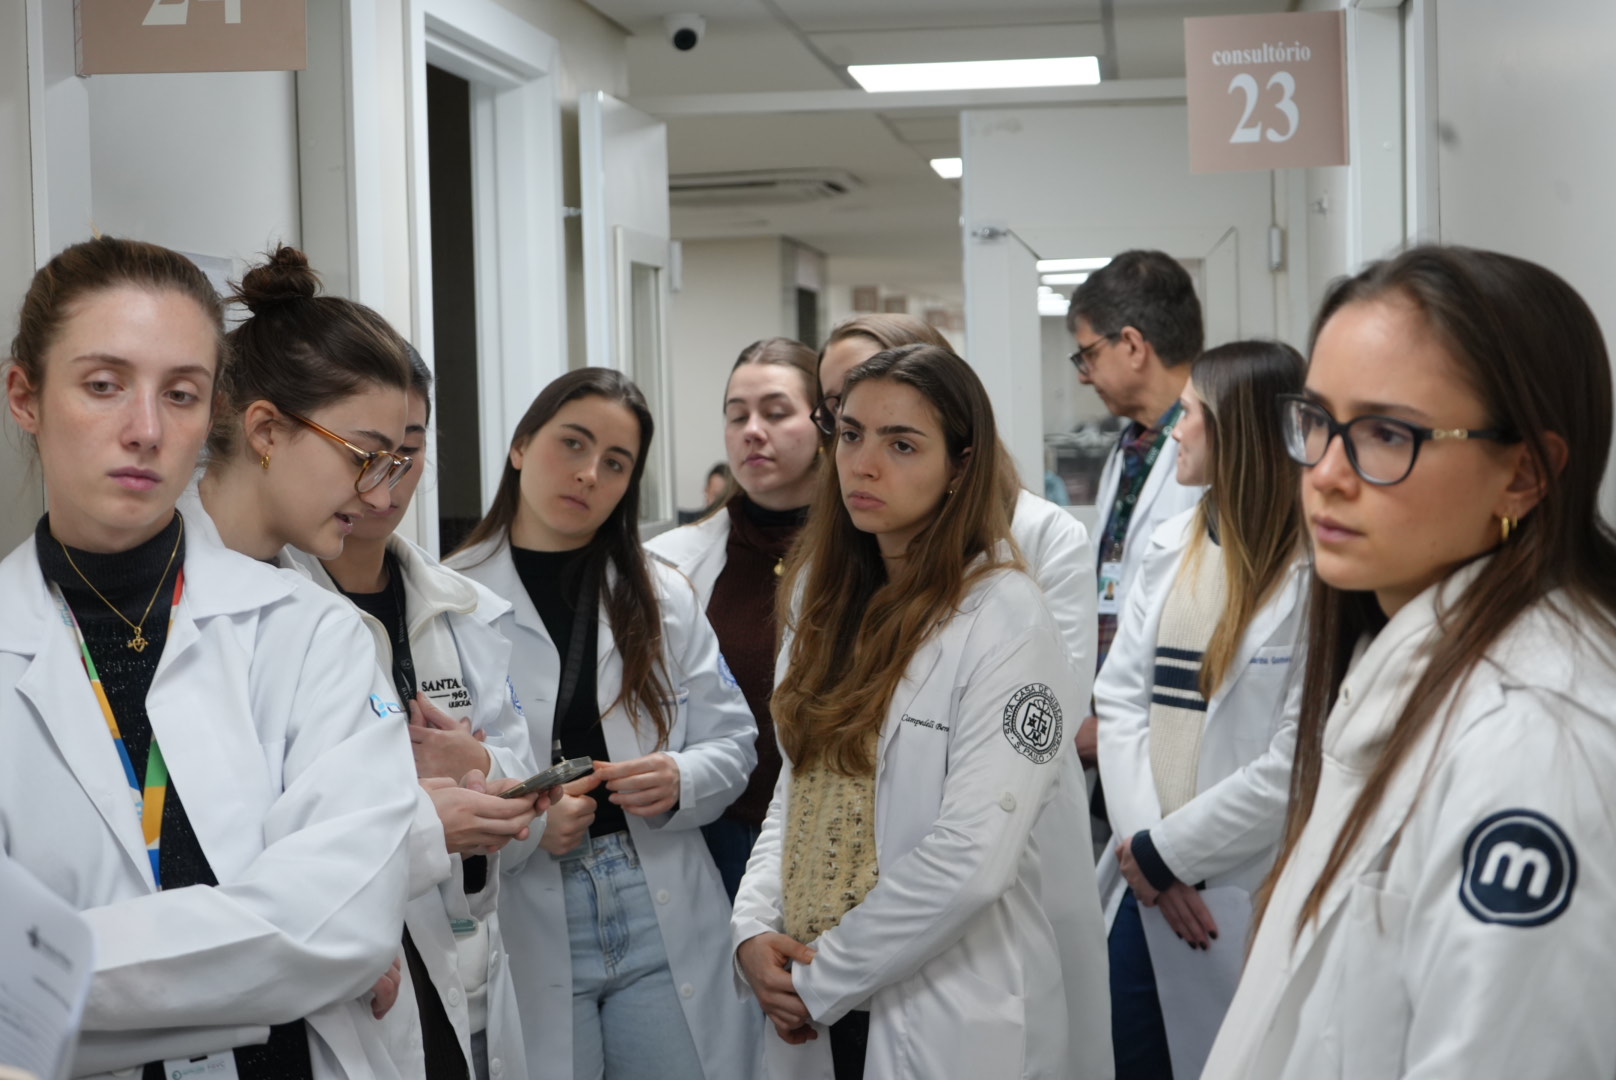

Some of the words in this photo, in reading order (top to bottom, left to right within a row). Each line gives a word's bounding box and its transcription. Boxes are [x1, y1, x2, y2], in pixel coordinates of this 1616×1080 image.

[1211, 41, 1312, 66] consultório
[1227, 71, 1299, 143] 23
[421, 678, 461, 692] SANTA
[1004, 704, 1014, 734] SANTA
[1014, 684, 1035, 701] CASA
[1479, 840, 1551, 899] m
